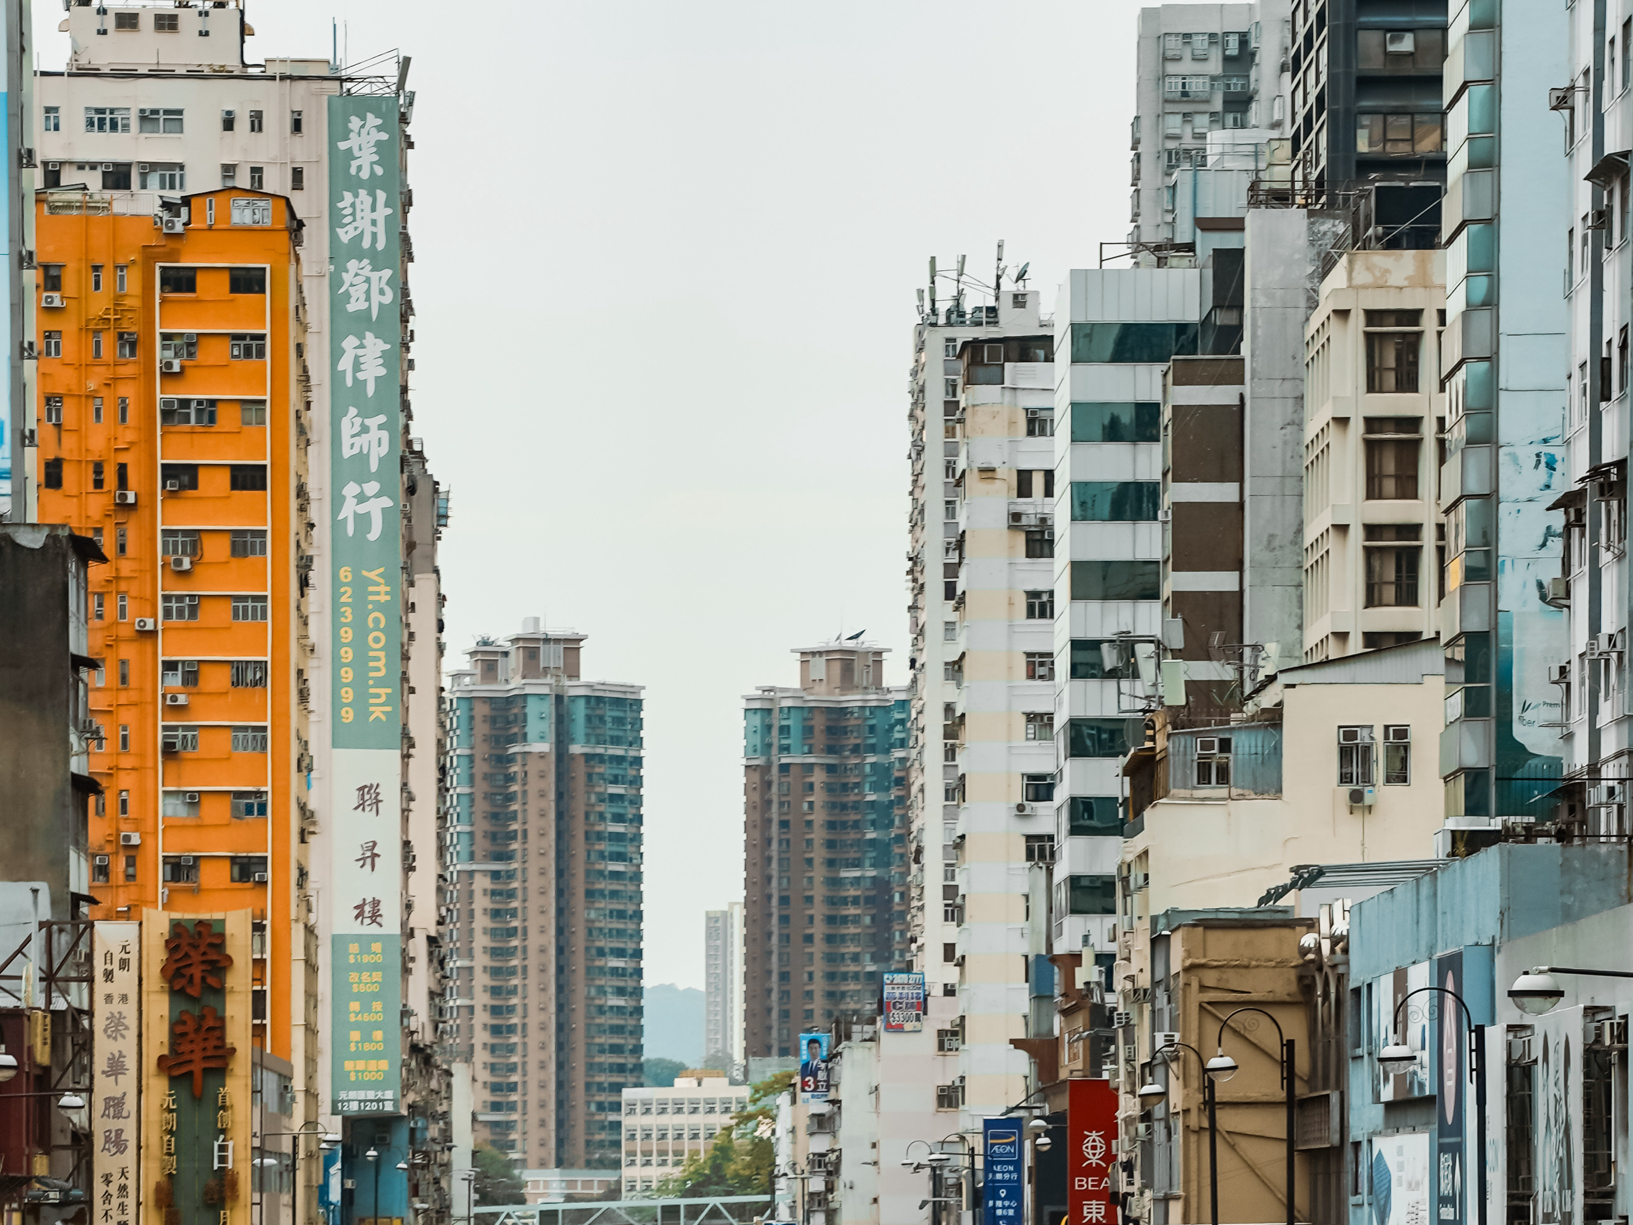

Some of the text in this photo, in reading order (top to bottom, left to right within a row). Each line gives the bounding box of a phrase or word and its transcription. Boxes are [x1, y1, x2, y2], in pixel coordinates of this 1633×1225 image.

[336, 111, 393, 542] 葉謝鄧律師行
[338, 566, 355, 724] 62399999
[351, 782, 384, 928] 聯昇樓
[102, 950, 115, 984] 自製
[103, 993, 129, 1005] 香港
[117, 939, 131, 973] 元朗
[157, 920, 237, 1098] 榮華
[804, 1076, 815, 1091] 3
